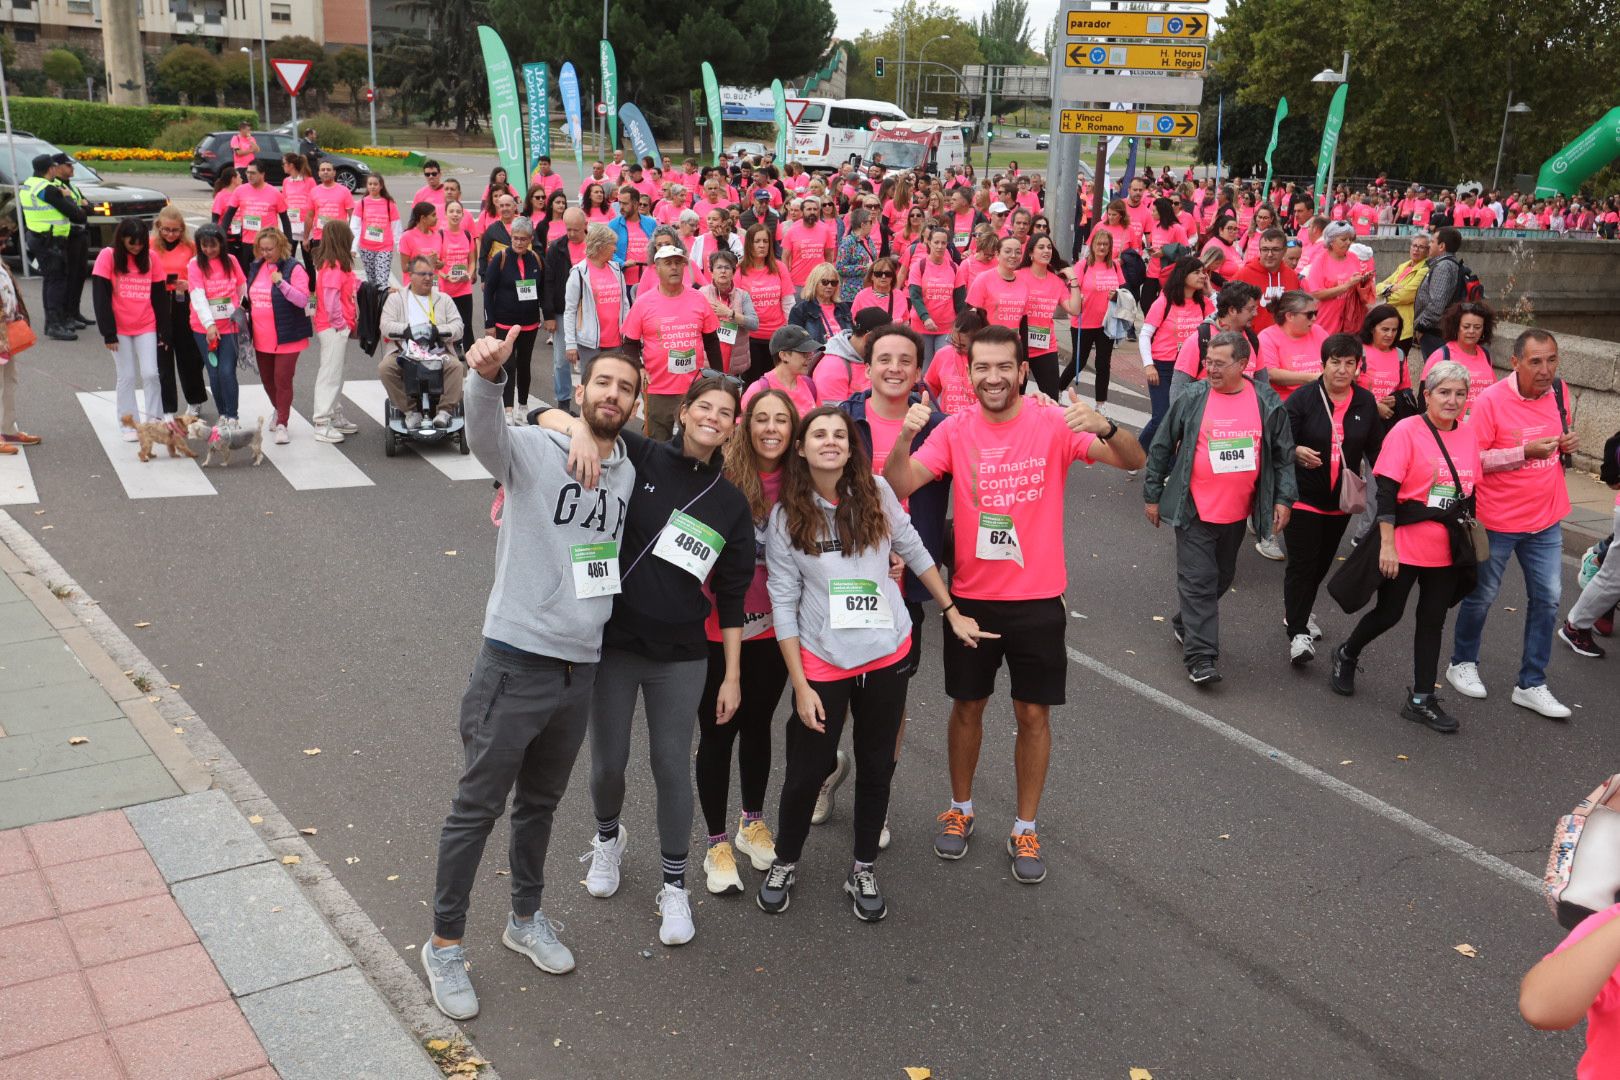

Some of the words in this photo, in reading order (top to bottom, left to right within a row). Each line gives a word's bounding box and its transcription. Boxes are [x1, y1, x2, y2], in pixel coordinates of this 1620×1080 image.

[1070, 19, 1111, 30] parador
[1160, 49, 1170, 58] H.
[1174, 49, 1202, 59] Horus
[1161, 58, 1171, 67] H.
[1174, 59, 1201, 69] Regio
[1063, 113, 1072, 122] H.
[1077, 114, 1103, 123] Vincci
[1062, 122, 1071, 131] H.
[1075, 122, 1084, 131] P.
[1087, 123, 1124, 132] Romano
[671, 323, 698, 331] marcha
[661, 331, 689, 340] contra
[1212, 429, 1226, 438] En
[1219, 449, 1245, 462] 4694
[979, 461, 996, 474] En
[998, 455, 1047, 473] marcha
[979, 474, 1028, 491] contra
[1030, 469, 1045, 483] el
[980, 487, 1045, 508] cáncer
[553, 482, 627, 540] GAP
[674, 532, 711, 561] 4860
[587, 561, 609, 578] 4861
[845, 595, 878, 611] 6212
